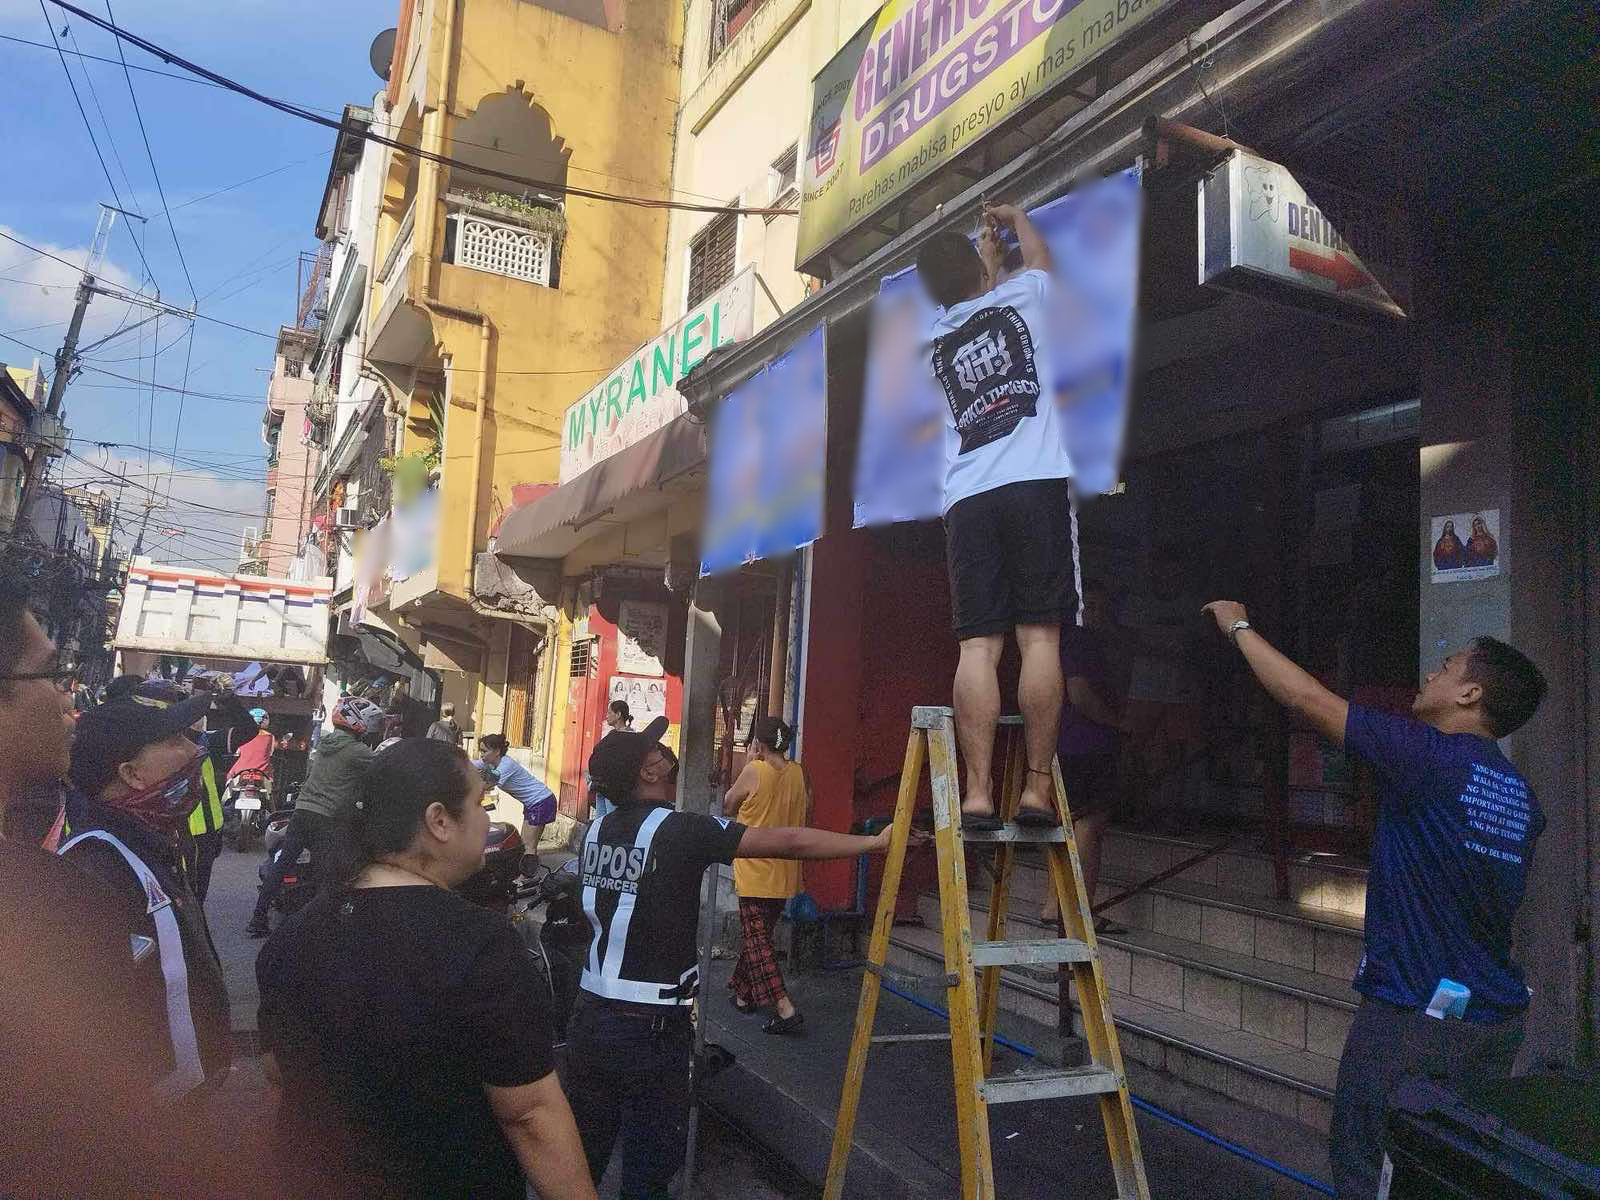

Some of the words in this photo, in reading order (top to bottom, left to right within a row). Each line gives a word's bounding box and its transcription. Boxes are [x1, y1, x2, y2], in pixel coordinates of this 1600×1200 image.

[849, 172, 895, 217] Parehas
[899, 134, 947, 183] mabisa
[951, 92, 1005, 150] presyo
[1009, 72, 1030, 101] ay
[1035, 39, 1075, 83] mas
[1082, 0, 1147, 49] maba
[854, 0, 990, 121] GENERI
[568, 302, 736, 452] MYRANEL
[582, 874, 639, 895] ENFORCER
[584, 842, 643, 882] DPOS
